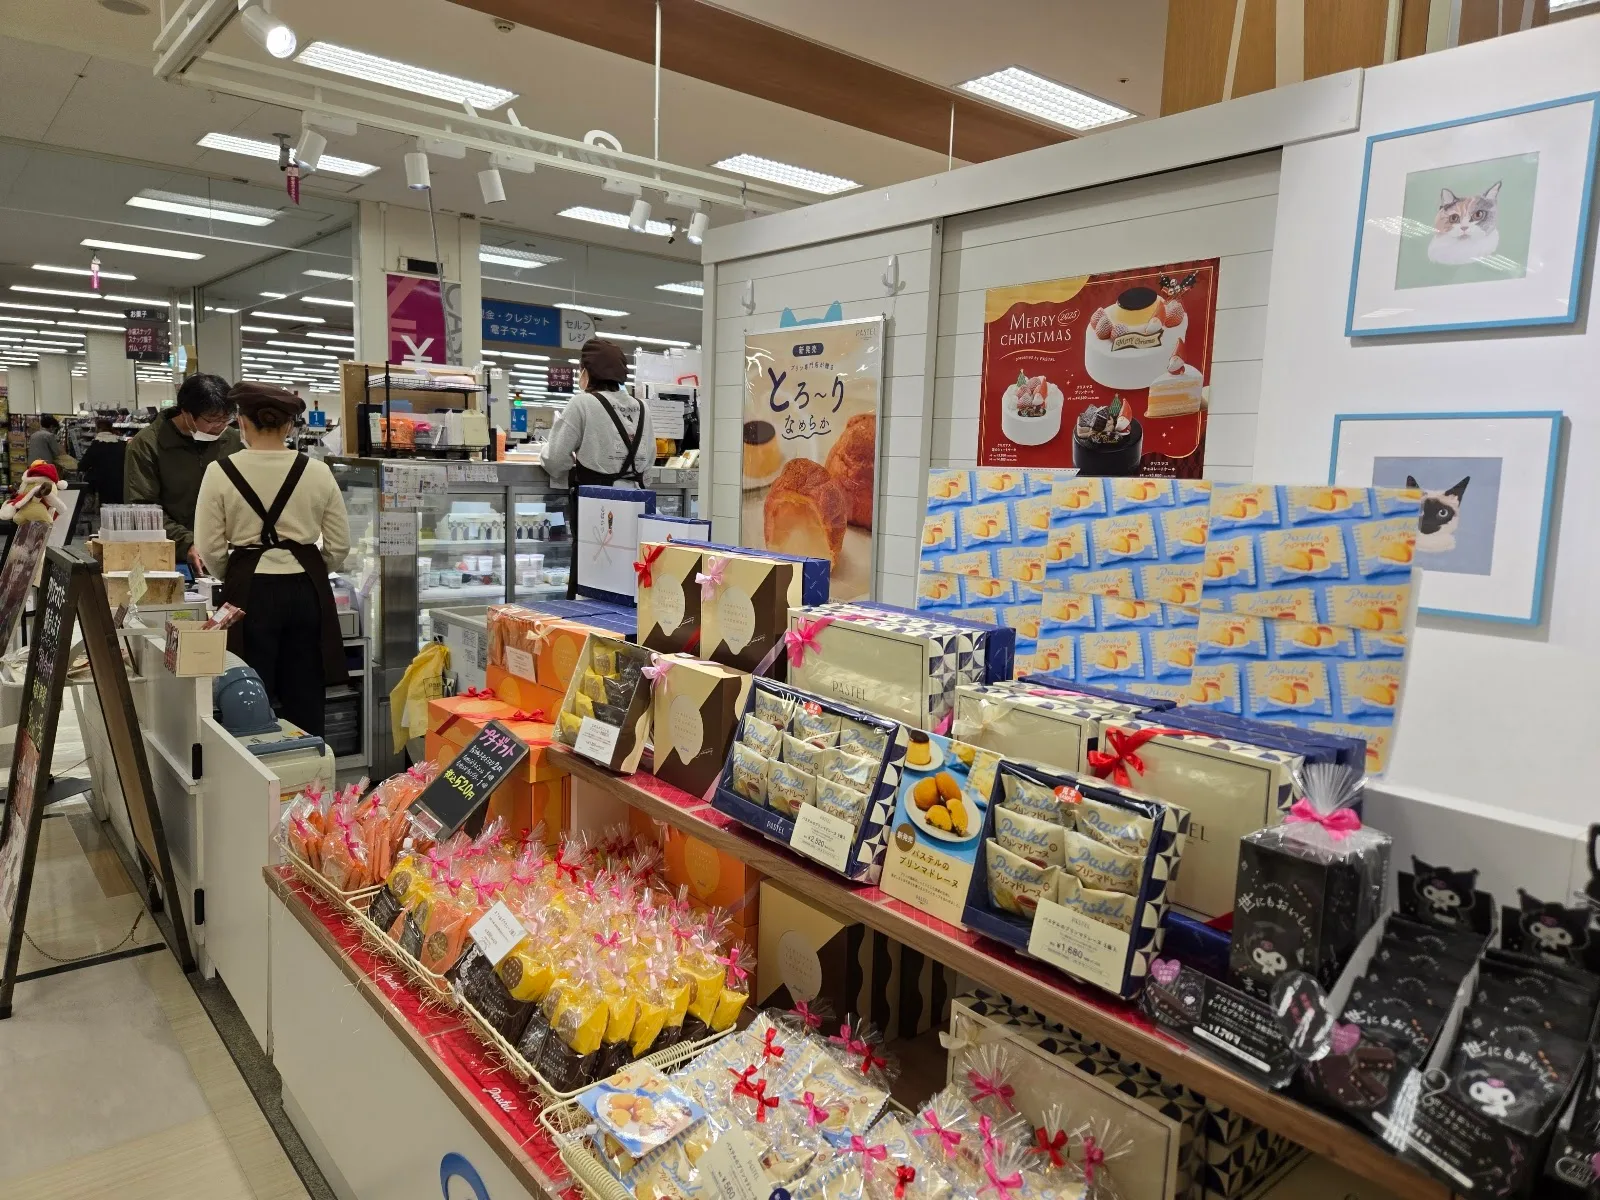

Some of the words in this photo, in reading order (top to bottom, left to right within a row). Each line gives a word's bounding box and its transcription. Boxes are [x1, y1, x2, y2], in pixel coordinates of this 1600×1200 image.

[130, 310, 147, 318] お菓子
[564, 318, 591, 331] セルフ
[1010, 312, 1056, 331] MERRY
[490, 324, 537, 338] 電子マネー
[569, 332, 587, 343] レジ
[855, 327, 877, 337] PASTEL
[1000, 328, 1072, 346] CHRISTMAS
[314, 412, 318, 421] 1
[784, 414, 830, 434] なめらか
[831, 680, 868, 702] PASTEL
[479, 728, 517, 758] プチギフト
[443, 768, 475, 800] 税込520円
[770, 767, 806, 793] Pastel
[1012, 786, 1060, 814] Pastel
[1061, 786, 1078, 797] 見本
[766, 819, 786, 836] PASTEL
[897, 831, 915, 845] 新発売
[997, 817, 1050, 847] Pastel
[807, 833, 826, 849] ¥2,520
[1000, 834, 1050, 859] プリンマドレーヌ
[912, 849, 951, 872] パステルの
[990, 854, 1044, 885] Pastel
[1069, 847, 1135, 878] Pastel
[899, 855, 960, 890] プリンマドレーヌ
[1075, 864, 1135, 888] プリンマドレーヌ
[994, 871, 1043, 898] プリンマドレーヌ
[1055, 940, 1084, 960] ¥1,680
[481, 1087, 518, 1113] Pastel
